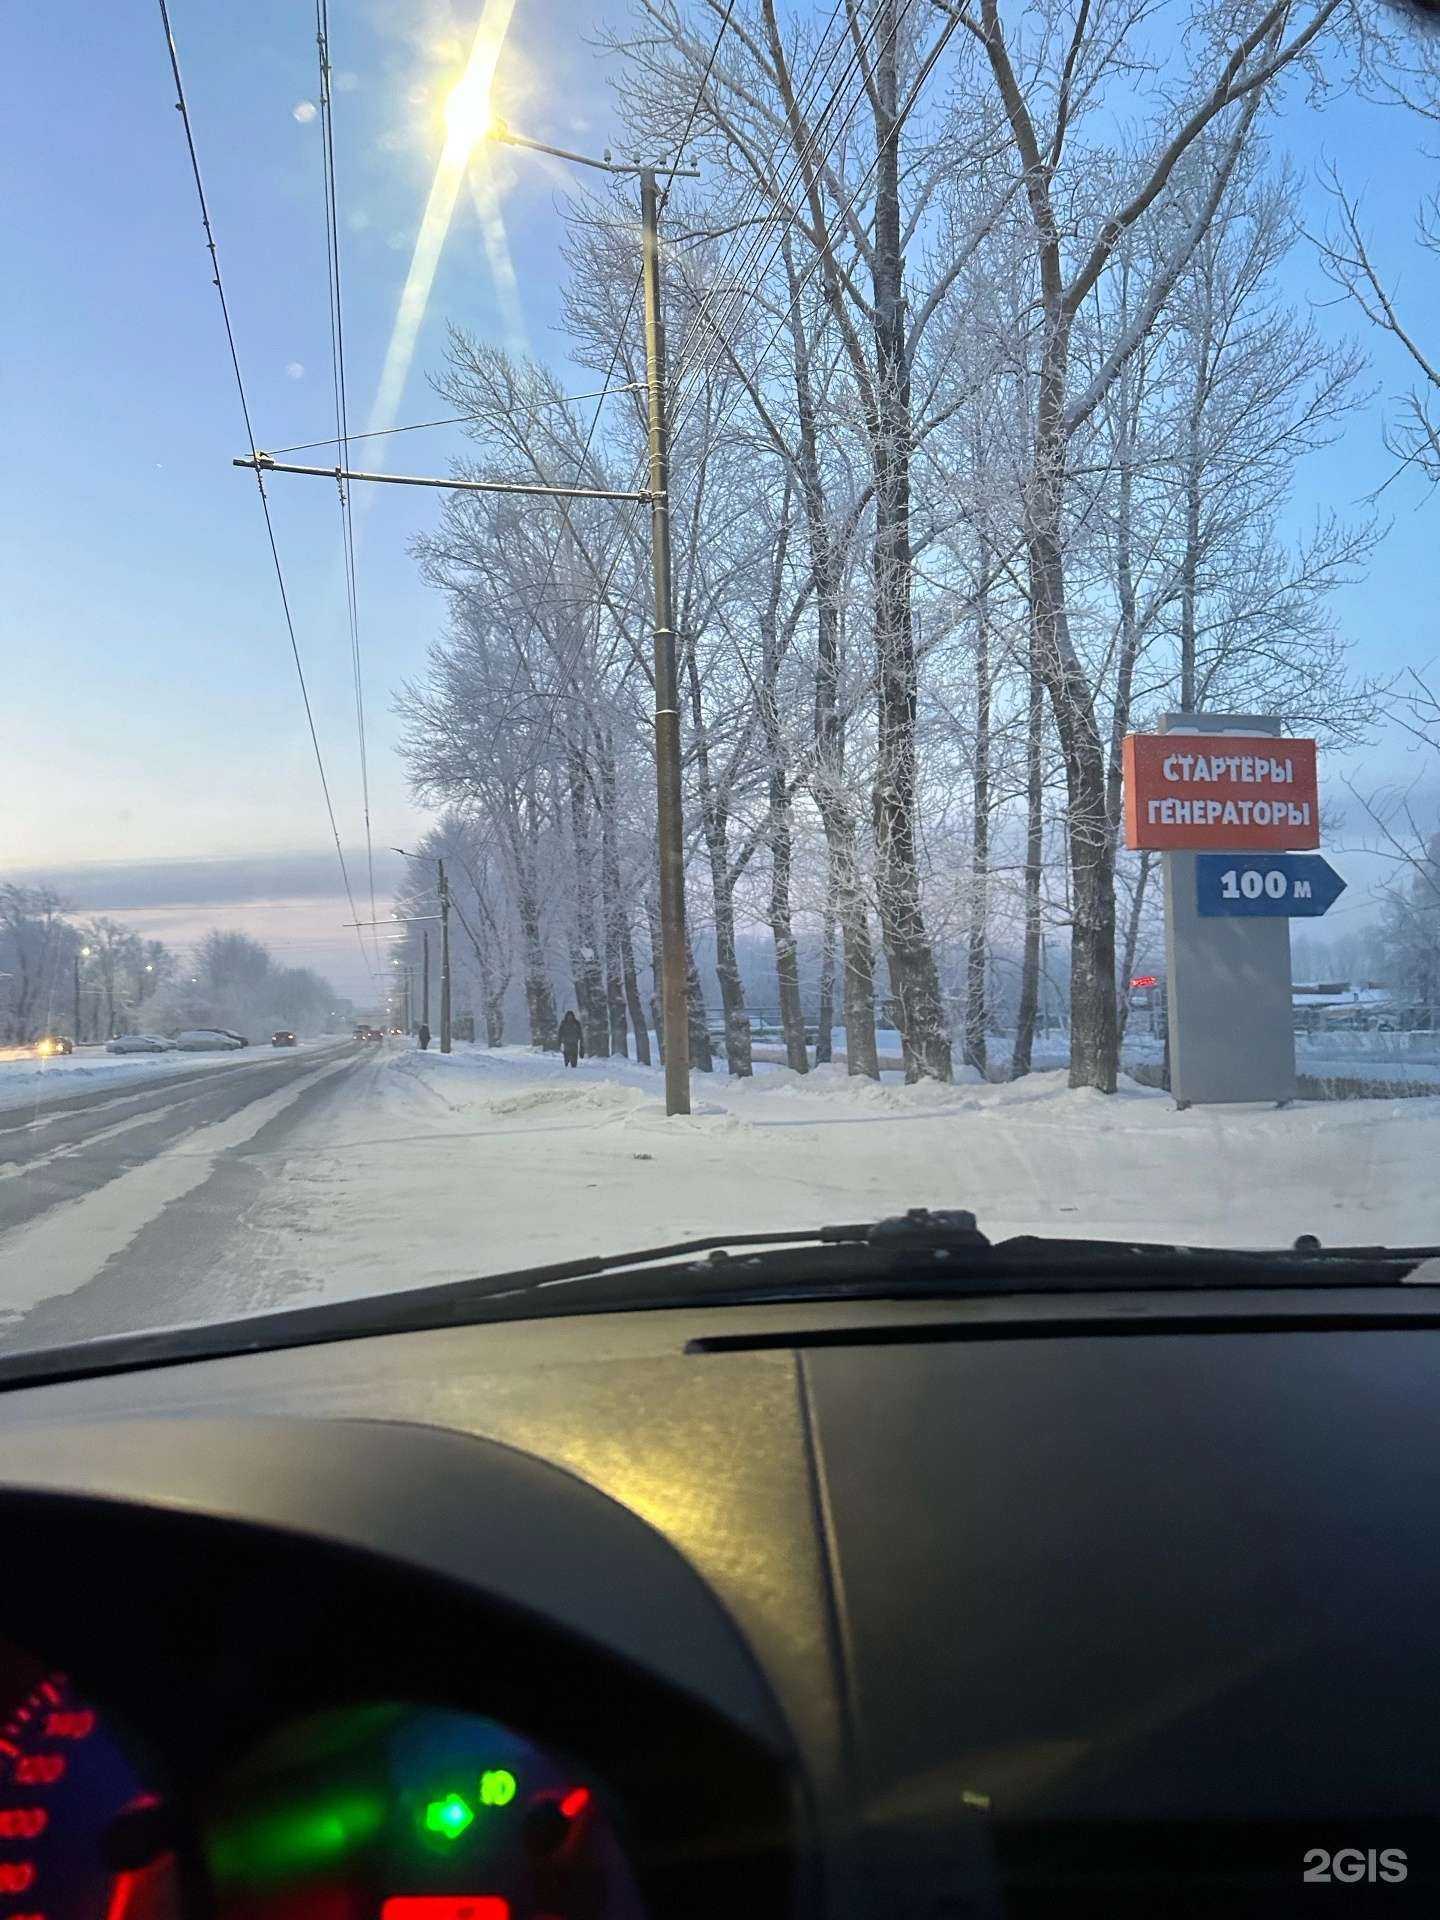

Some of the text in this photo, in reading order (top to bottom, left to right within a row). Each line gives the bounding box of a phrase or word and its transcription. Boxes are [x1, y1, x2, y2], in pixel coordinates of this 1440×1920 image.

[1162, 754, 1294, 783] СТАРТЕРЫ
[1148, 798, 1311, 826] ГЕНЕРАТОРЫ
[1220, 870, 1287, 899] 100
